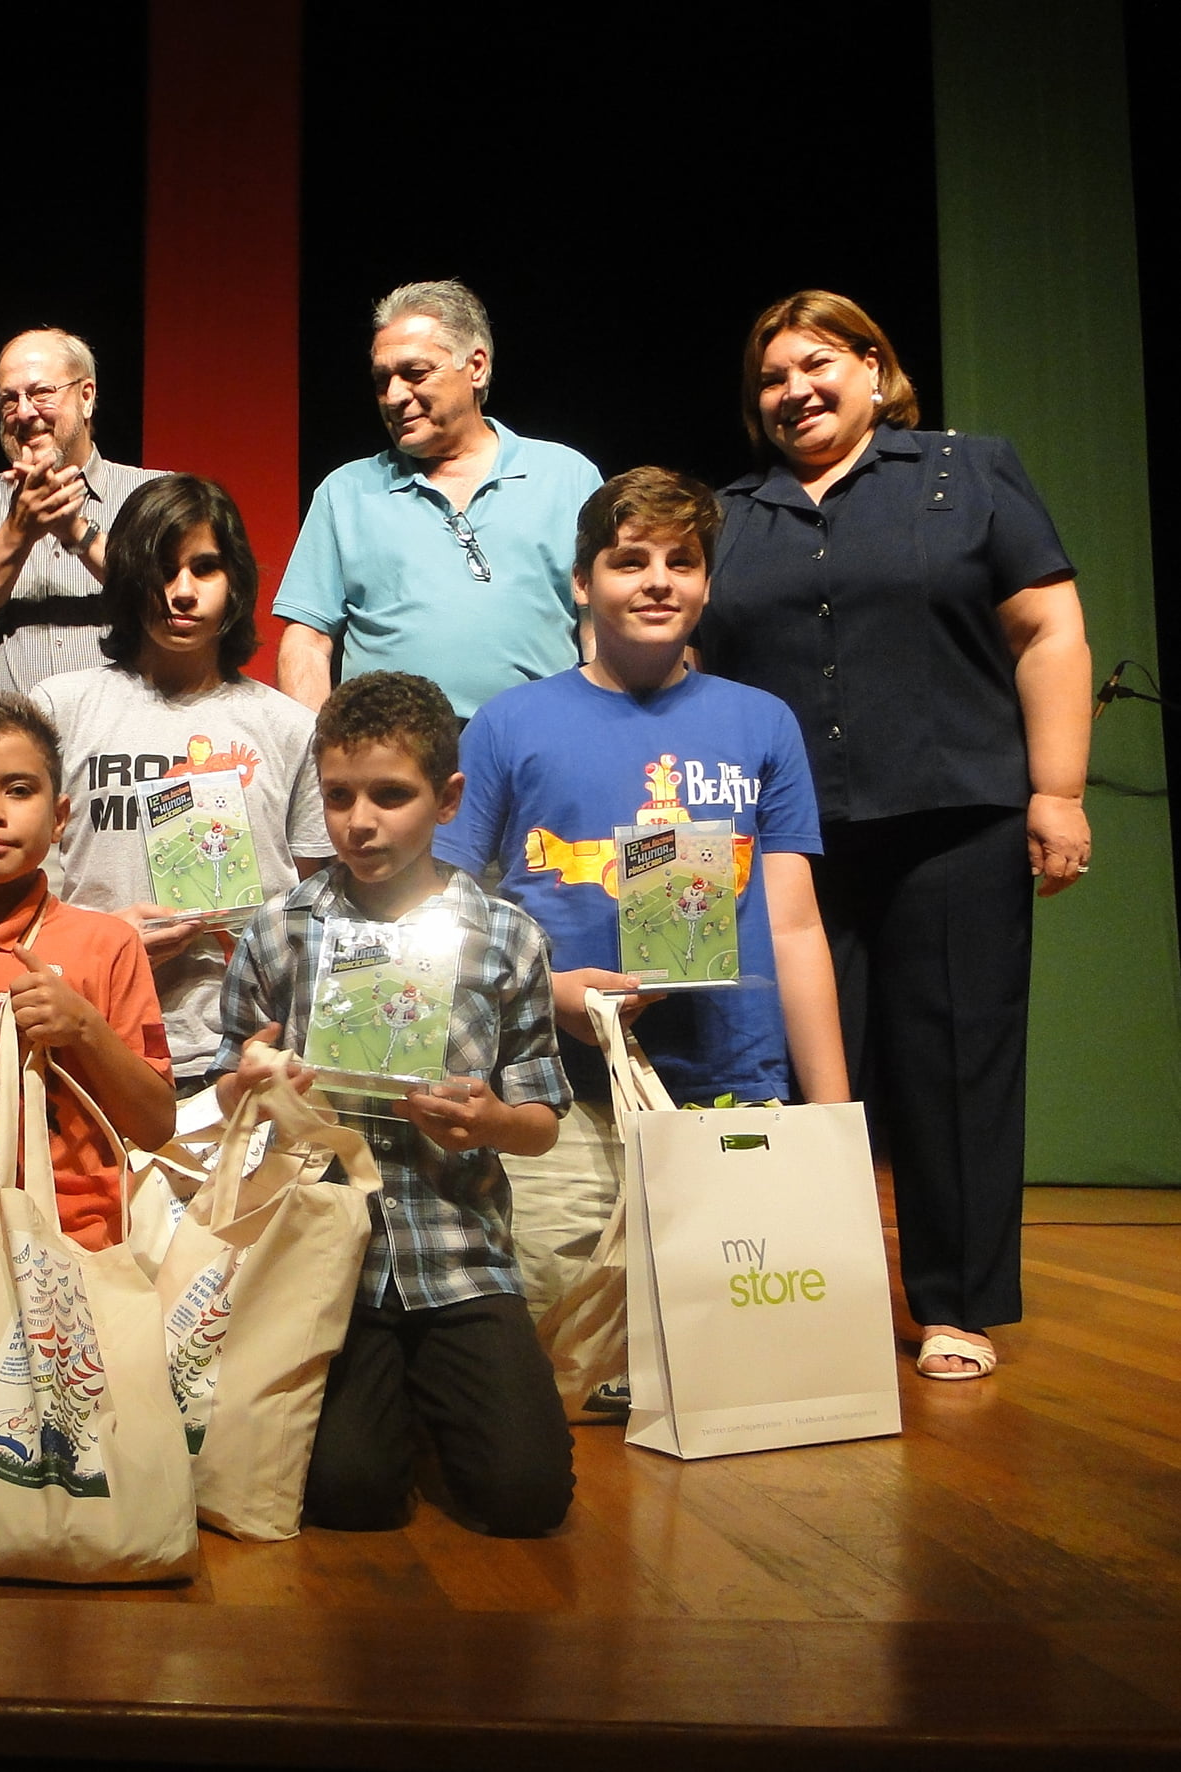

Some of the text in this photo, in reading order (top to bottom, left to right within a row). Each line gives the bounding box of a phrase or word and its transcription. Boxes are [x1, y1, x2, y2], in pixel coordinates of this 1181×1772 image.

[88, 754, 188, 791] IRO
[717, 762, 743, 779] THE
[722, 1238, 766, 1270] my
[730, 1267, 826, 1308] store
